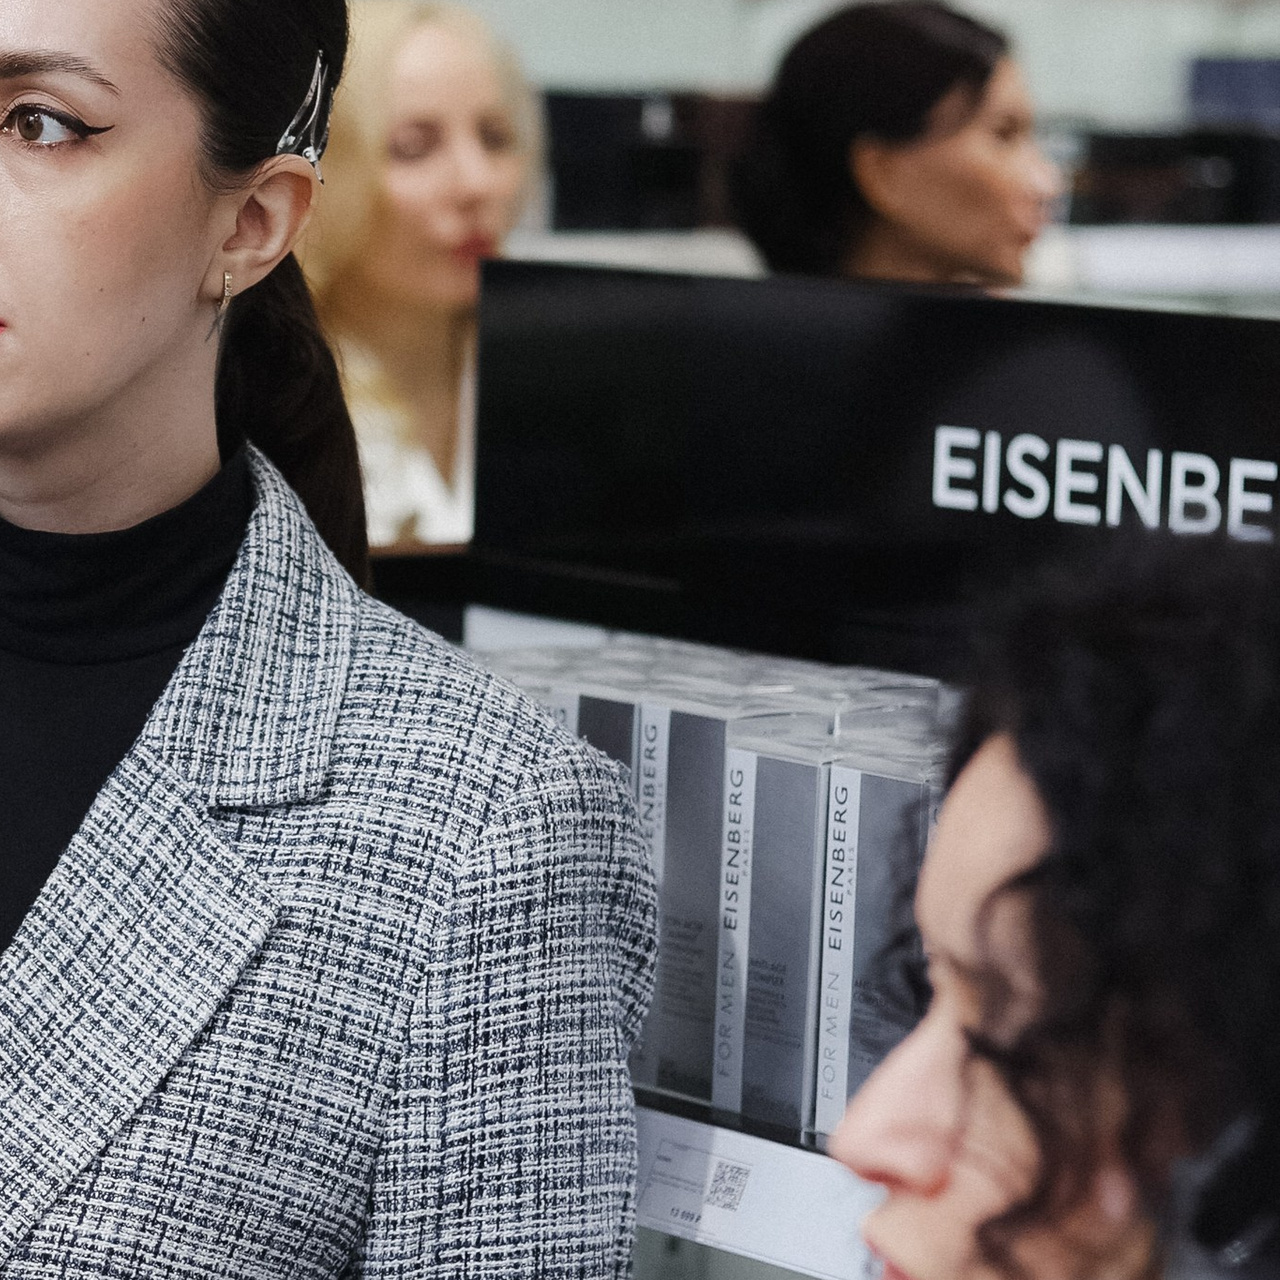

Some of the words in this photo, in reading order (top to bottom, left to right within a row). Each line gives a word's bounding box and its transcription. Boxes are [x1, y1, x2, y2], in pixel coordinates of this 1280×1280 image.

[931, 424, 1279, 543] EISENBE
[723, 769, 744, 932] EISENBERG
[828, 785, 849, 951] EISENBERG
[720, 951, 736, 1016] MEN
[824, 972, 840, 1038] MEN
[820, 1046, 837, 1101] FOR
